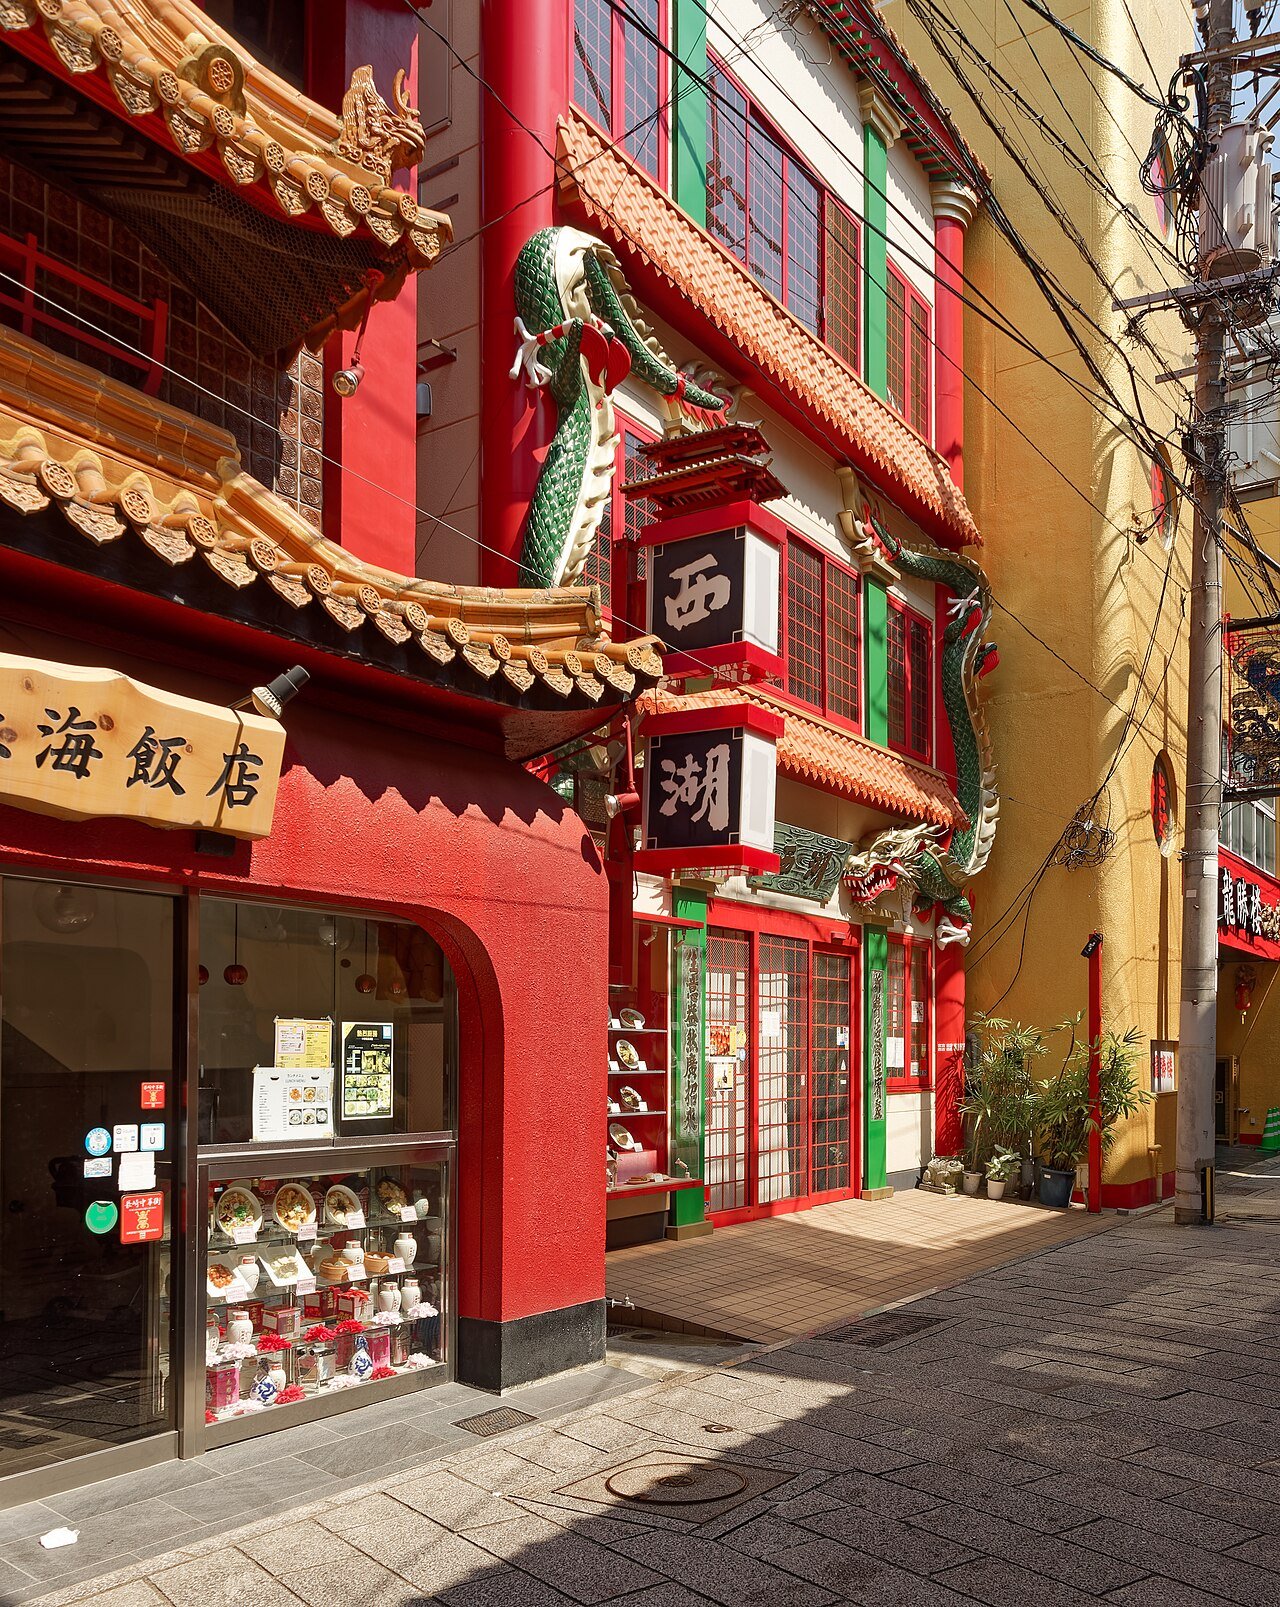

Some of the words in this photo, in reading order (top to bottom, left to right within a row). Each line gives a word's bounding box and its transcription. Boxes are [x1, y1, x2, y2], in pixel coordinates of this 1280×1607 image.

[664, 553, 731, 631] 西
[0, 707, 264, 809] 海飯店
[659, 743, 731, 832] 湖
